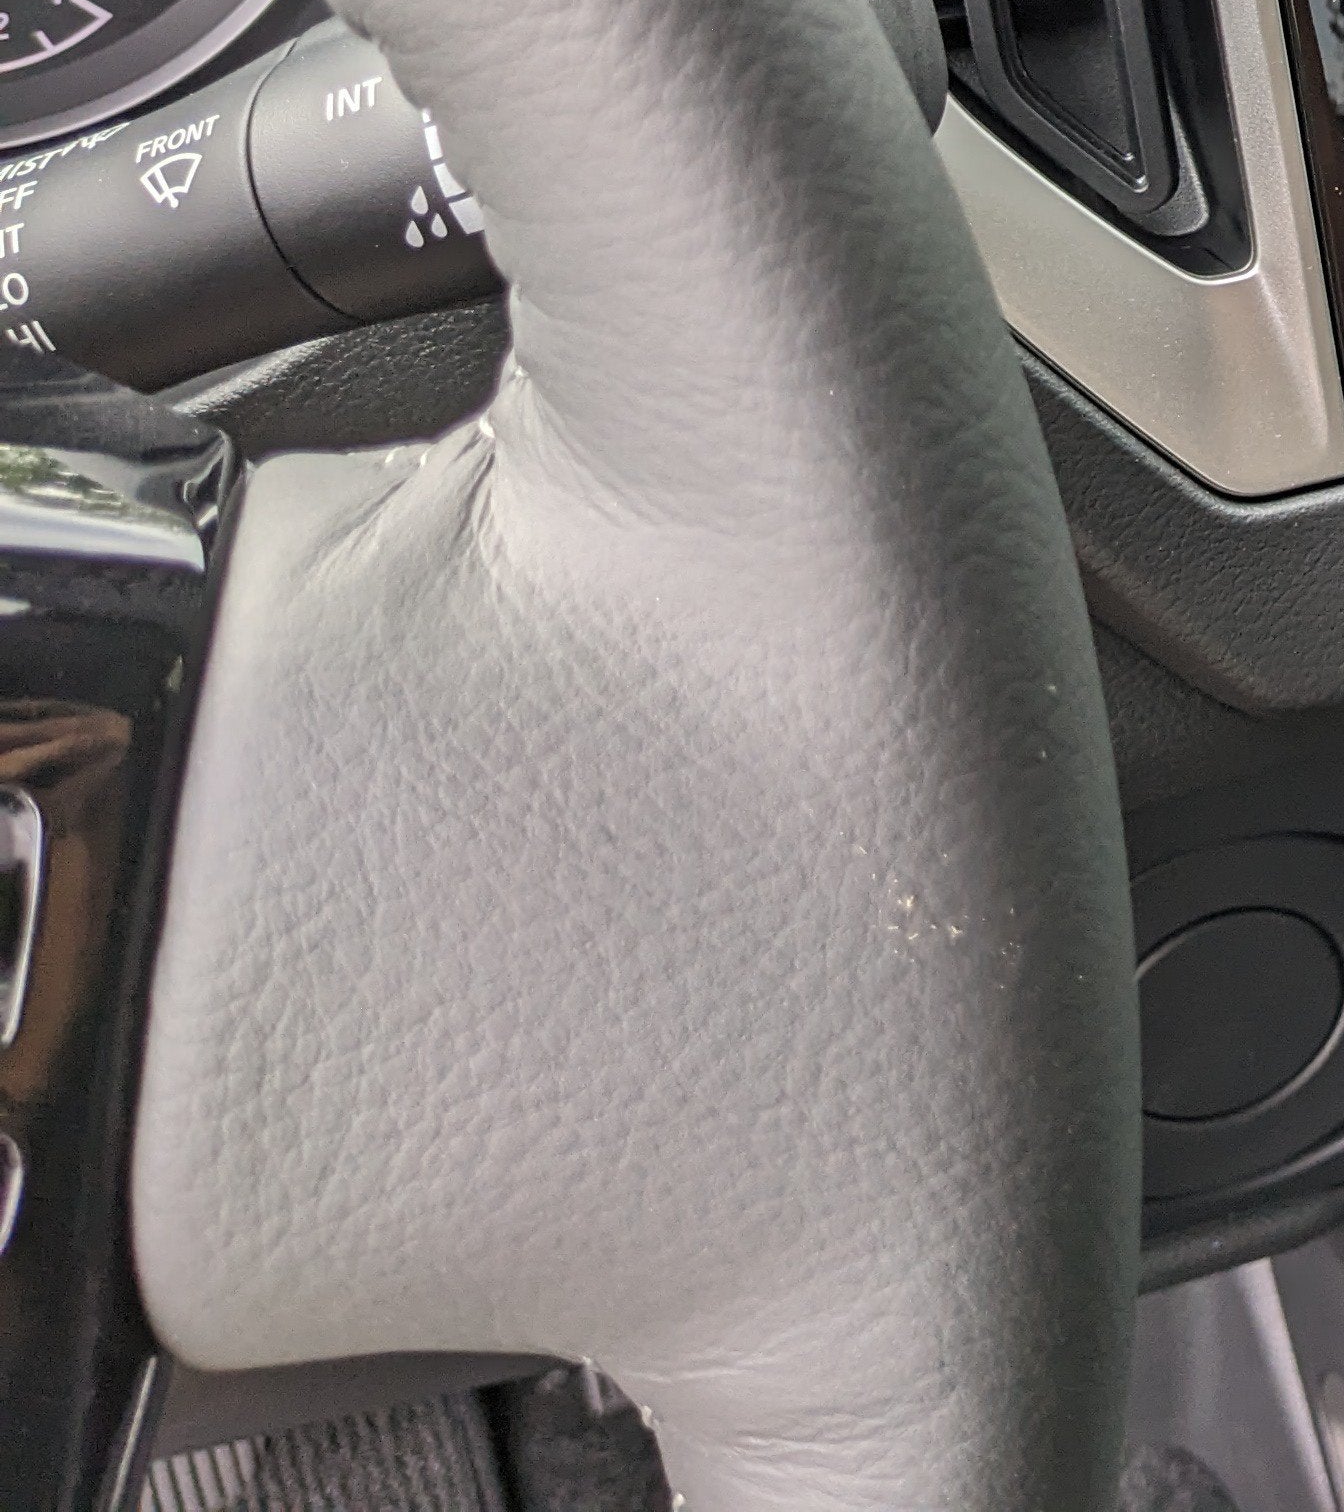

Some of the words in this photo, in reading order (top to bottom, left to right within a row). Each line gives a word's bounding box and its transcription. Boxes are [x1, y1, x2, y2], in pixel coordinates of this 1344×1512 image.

[325, 77, 381, 120] INT
[135, 114, 220, 164] FRONT
[0, 148, 63, 182] IST
